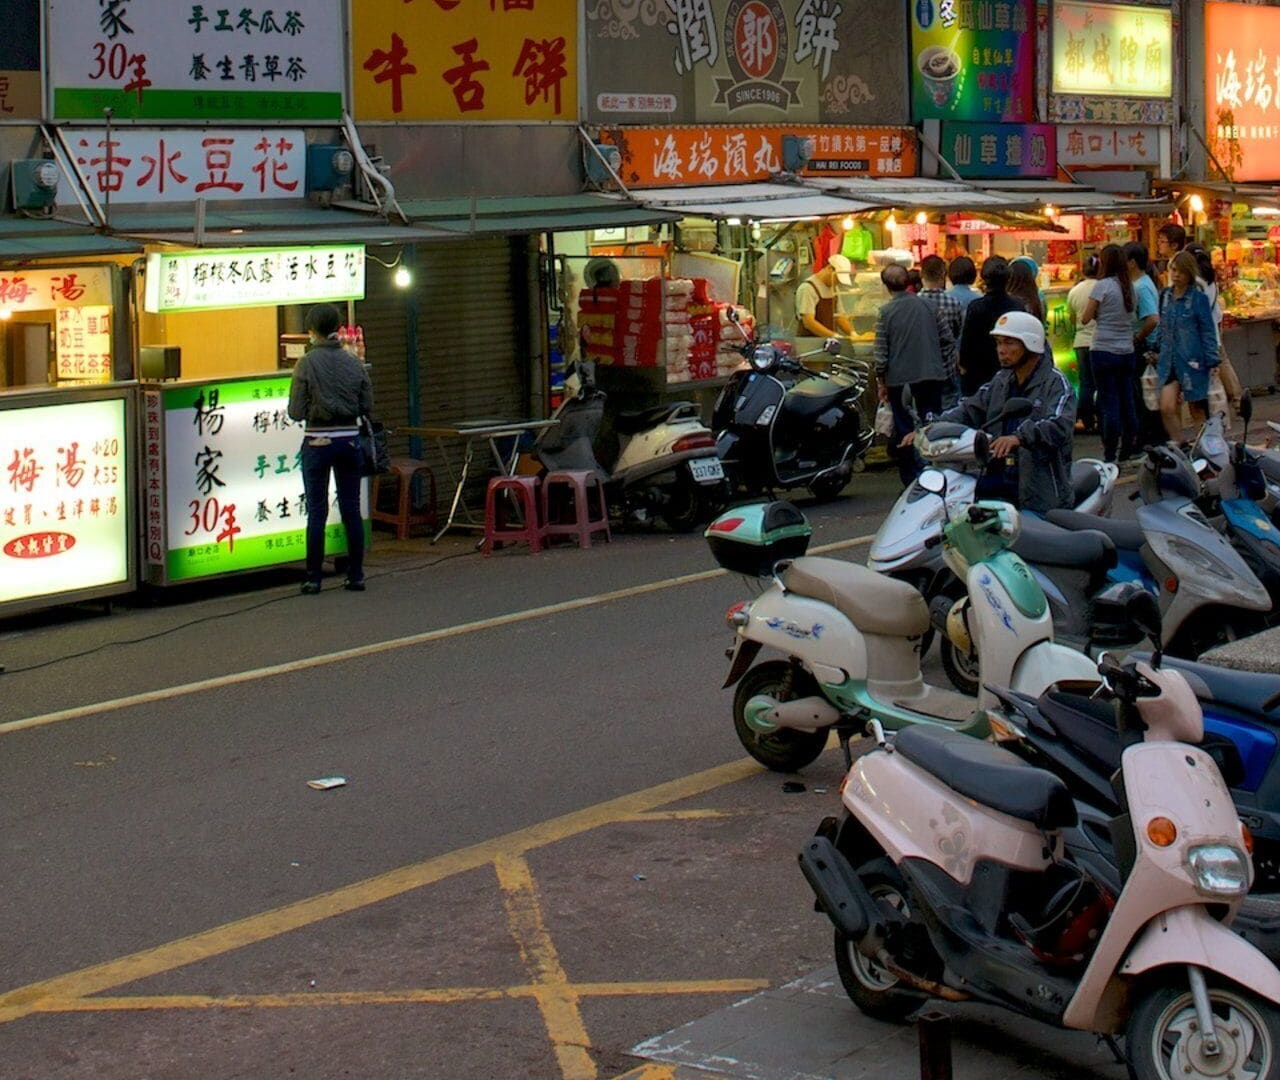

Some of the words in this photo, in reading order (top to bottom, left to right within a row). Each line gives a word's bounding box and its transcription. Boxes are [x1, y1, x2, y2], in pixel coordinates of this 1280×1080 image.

[187, 4, 305, 37] 手工冬瓜茶
[742, 8, 773, 71] 郭
[88, 41, 153, 108] 30年
[188, 52, 308, 84] 養生青草茶
[362, 31, 568, 116] 牛舌餅
[77, 136, 300, 196] 活水豆花
[1065, 128, 1148, 157] 廟口小吃
[193, 388, 227, 496] 楊家
[183, 496, 242, 555] 30年
